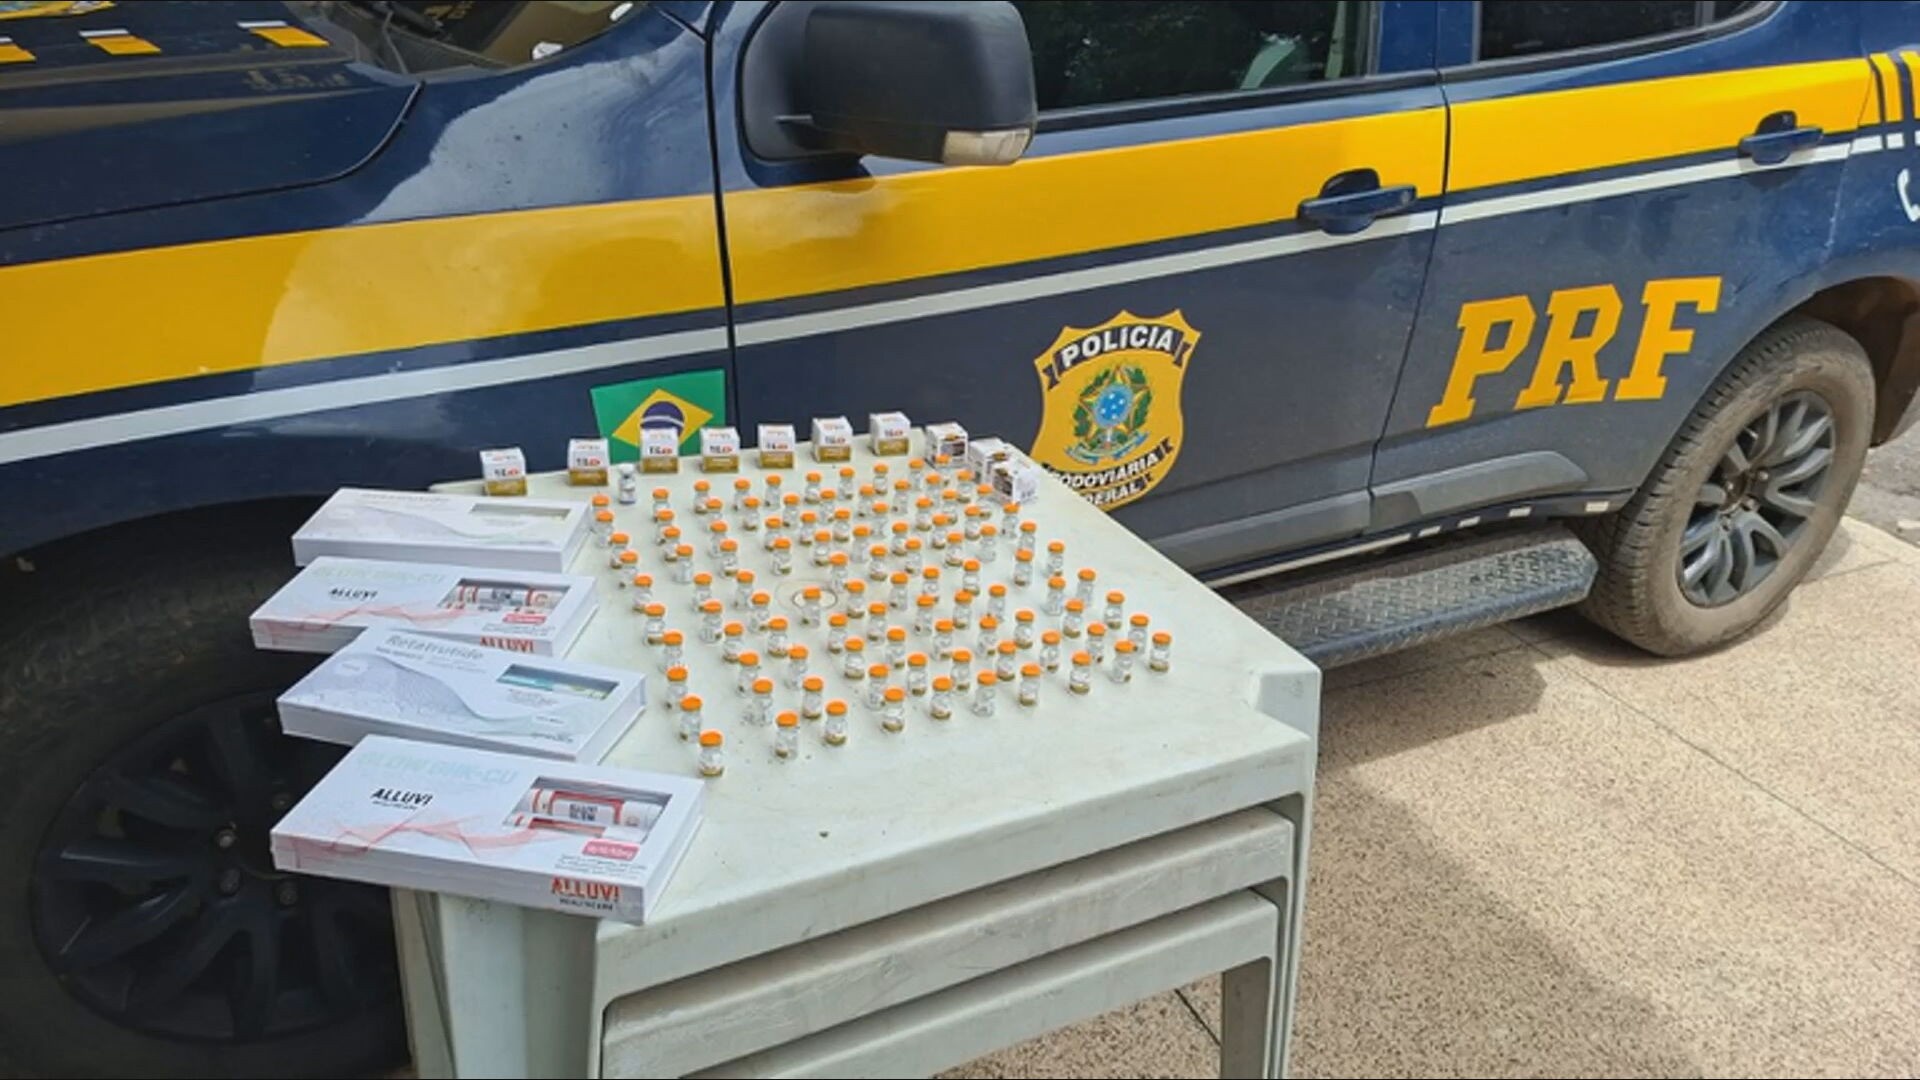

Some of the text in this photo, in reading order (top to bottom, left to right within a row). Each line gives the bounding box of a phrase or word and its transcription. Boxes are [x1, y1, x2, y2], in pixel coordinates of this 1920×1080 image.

[1425, 276, 1722, 428] PRF
[1058, 452, 1159, 489] ODOVIARIA
[370, 788, 433, 806] ALLUVI
[551, 875, 621, 903] ALLUVI
